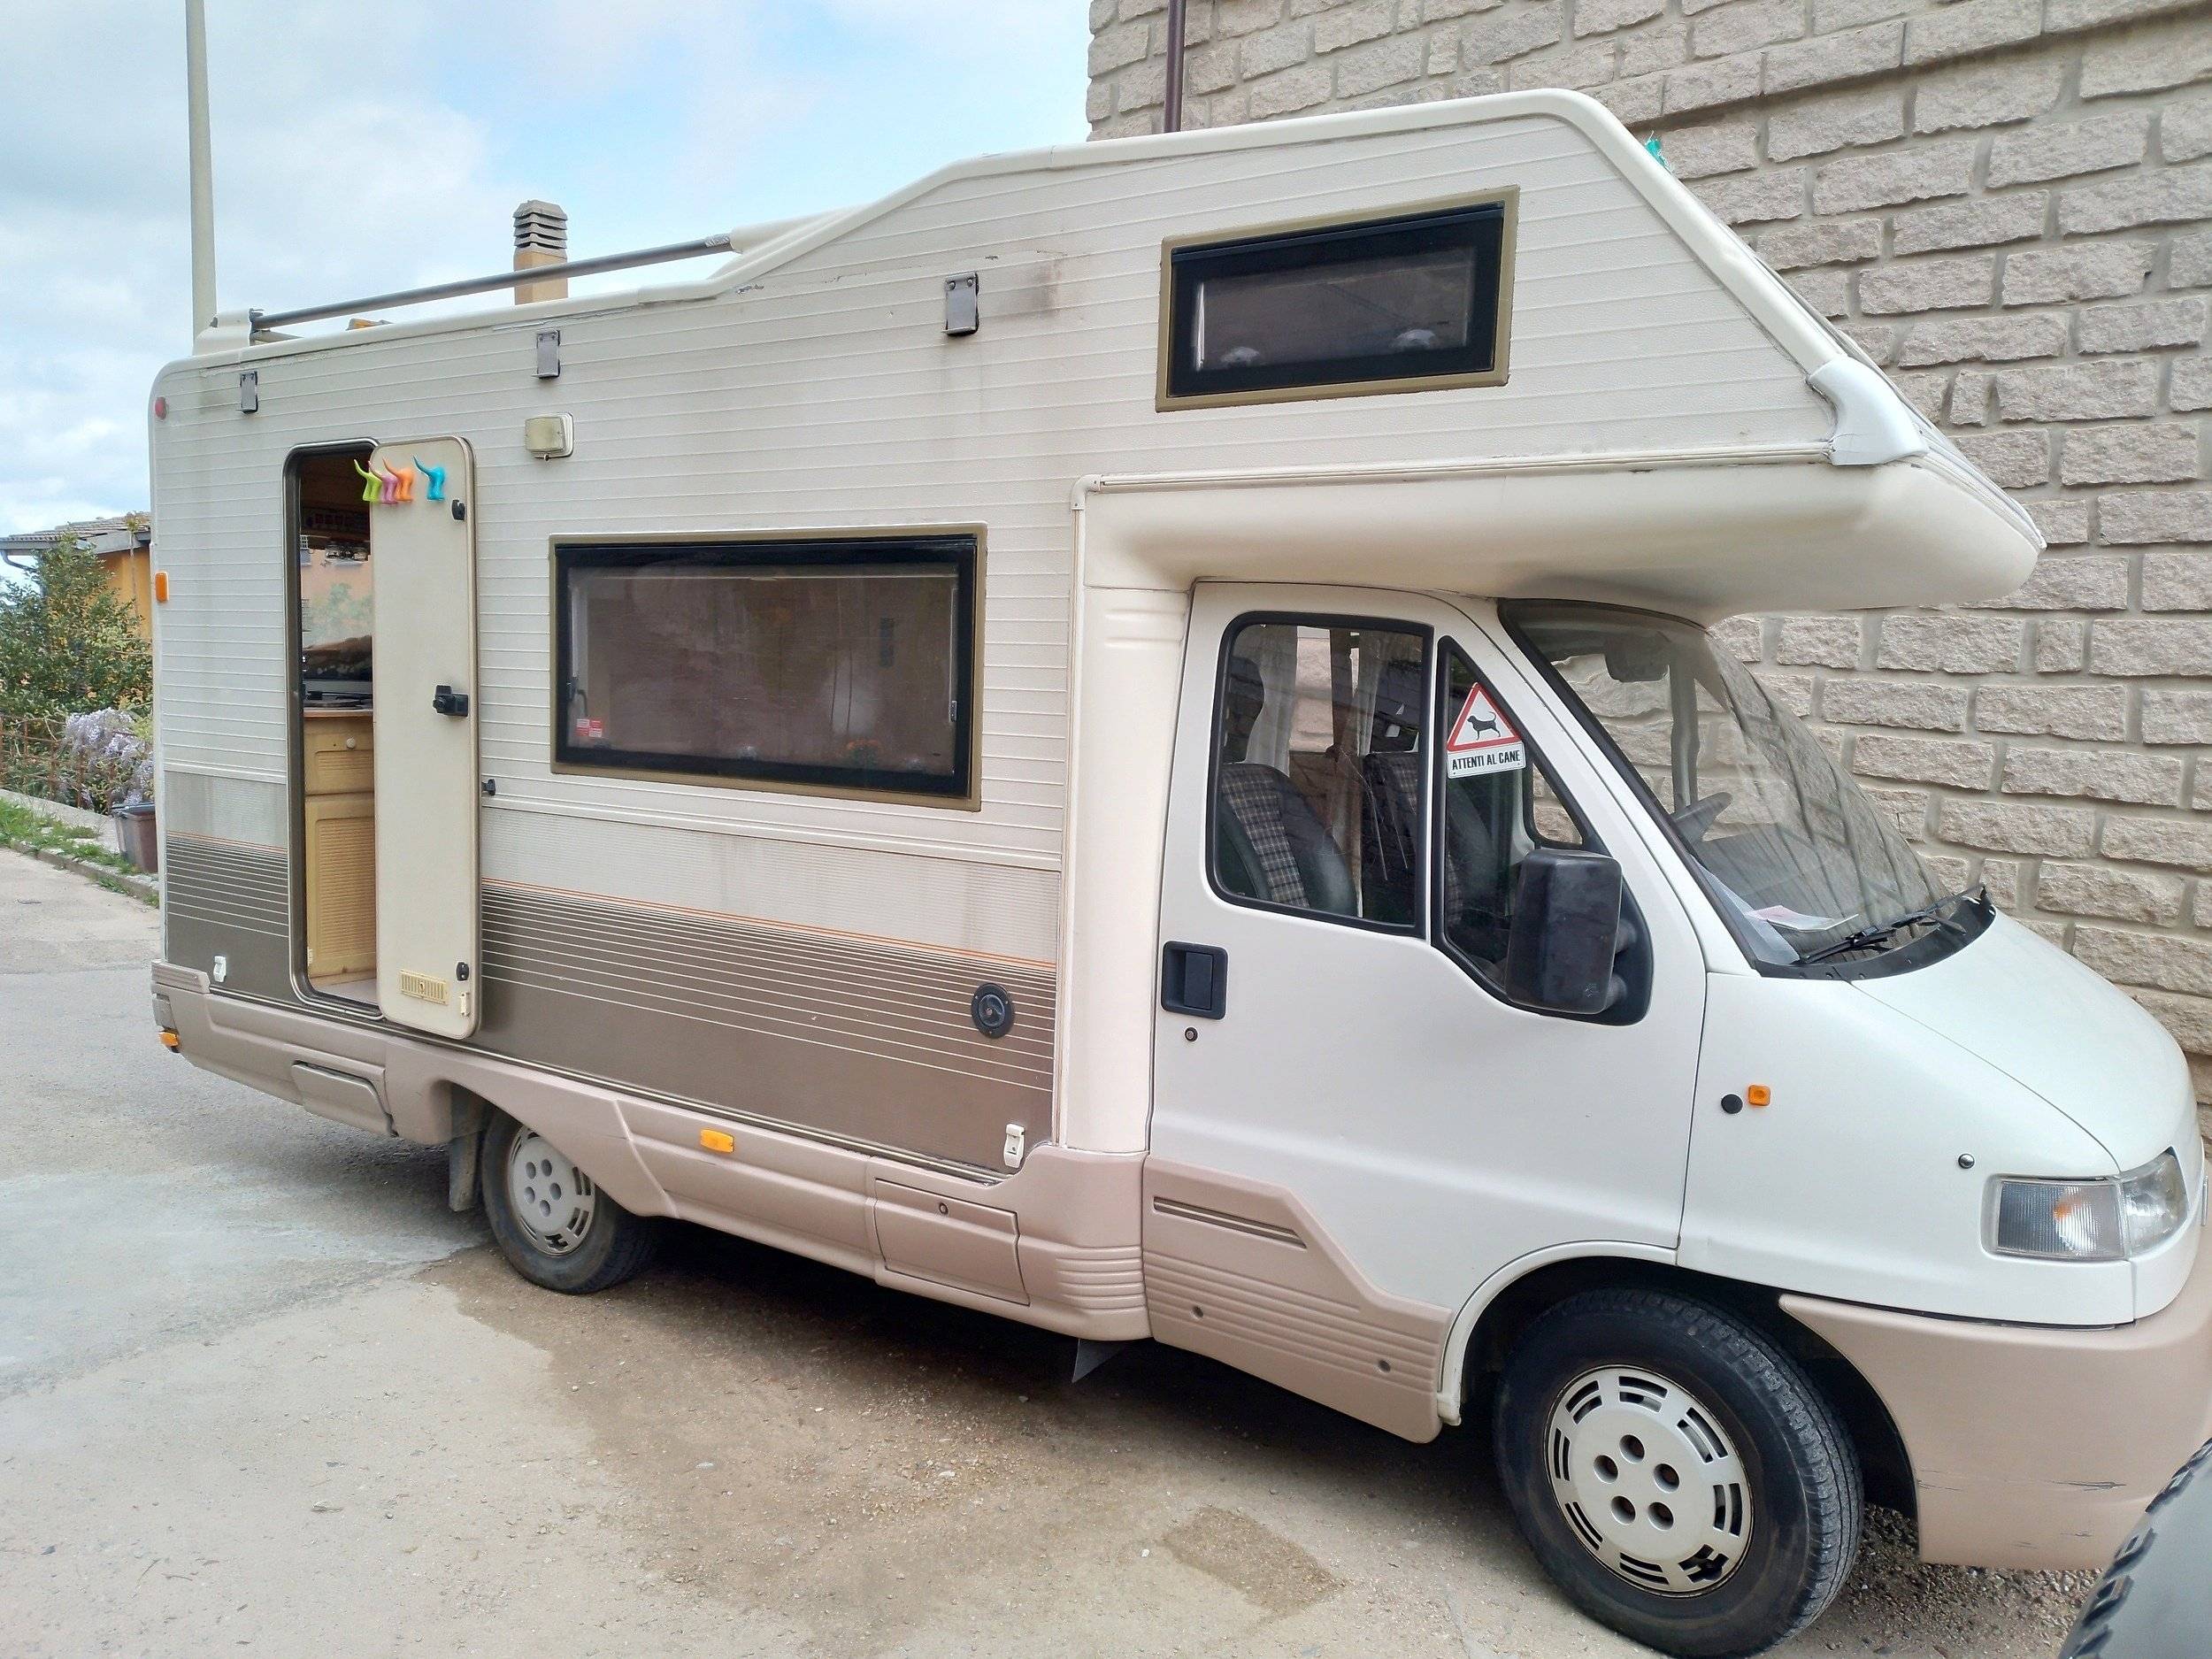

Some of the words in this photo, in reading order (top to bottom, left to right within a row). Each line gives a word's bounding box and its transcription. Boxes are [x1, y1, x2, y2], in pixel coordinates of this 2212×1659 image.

[1452, 755, 1485, 770] ATTENTI
[1486, 754, 1497, 765] AL
[1499, 750, 1520, 764] CANE
